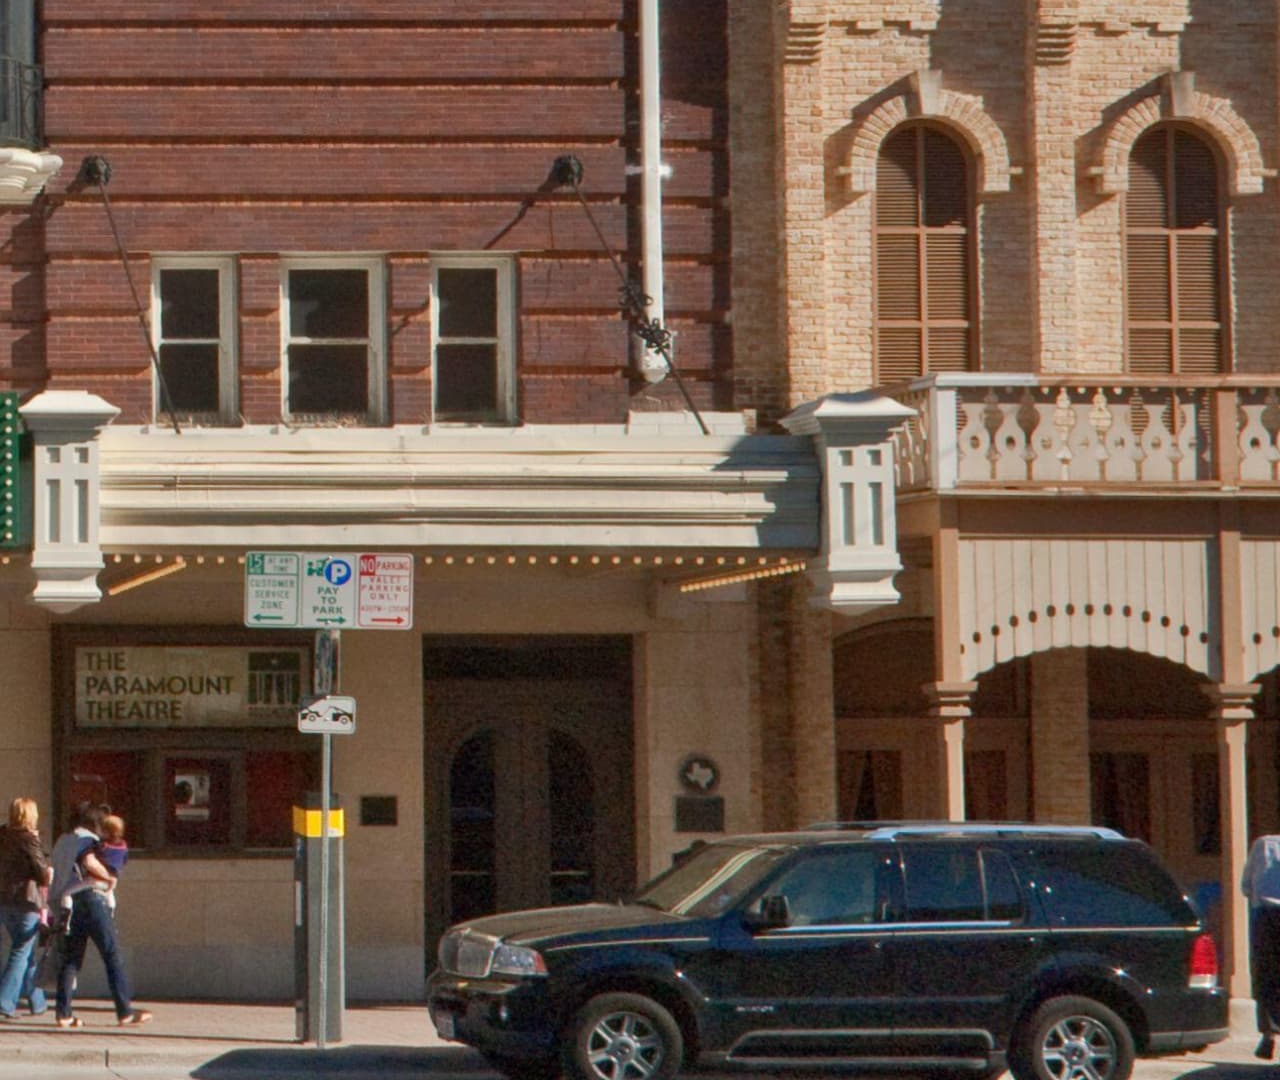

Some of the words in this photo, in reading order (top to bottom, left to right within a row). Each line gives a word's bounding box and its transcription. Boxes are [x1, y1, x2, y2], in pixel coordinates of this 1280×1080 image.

[361, 559, 375, 572] NO
[377, 561, 409, 570] PARKING
[249, 579, 295, 588] CUSTOMER
[361, 584, 409, 592] PARKING
[255, 590, 289, 599] SERVICE
[317, 587, 339, 595] PAY
[321, 596, 337, 605] TO
[370, 593, 398, 601] ONLY
[260, 600, 283, 609] ZONE
[313, 606, 343, 614] PARK
[85, 651, 126, 671] THE
[85, 675, 235, 696] PARAMOUNT
[85, 699, 182, 720] THEATRE
